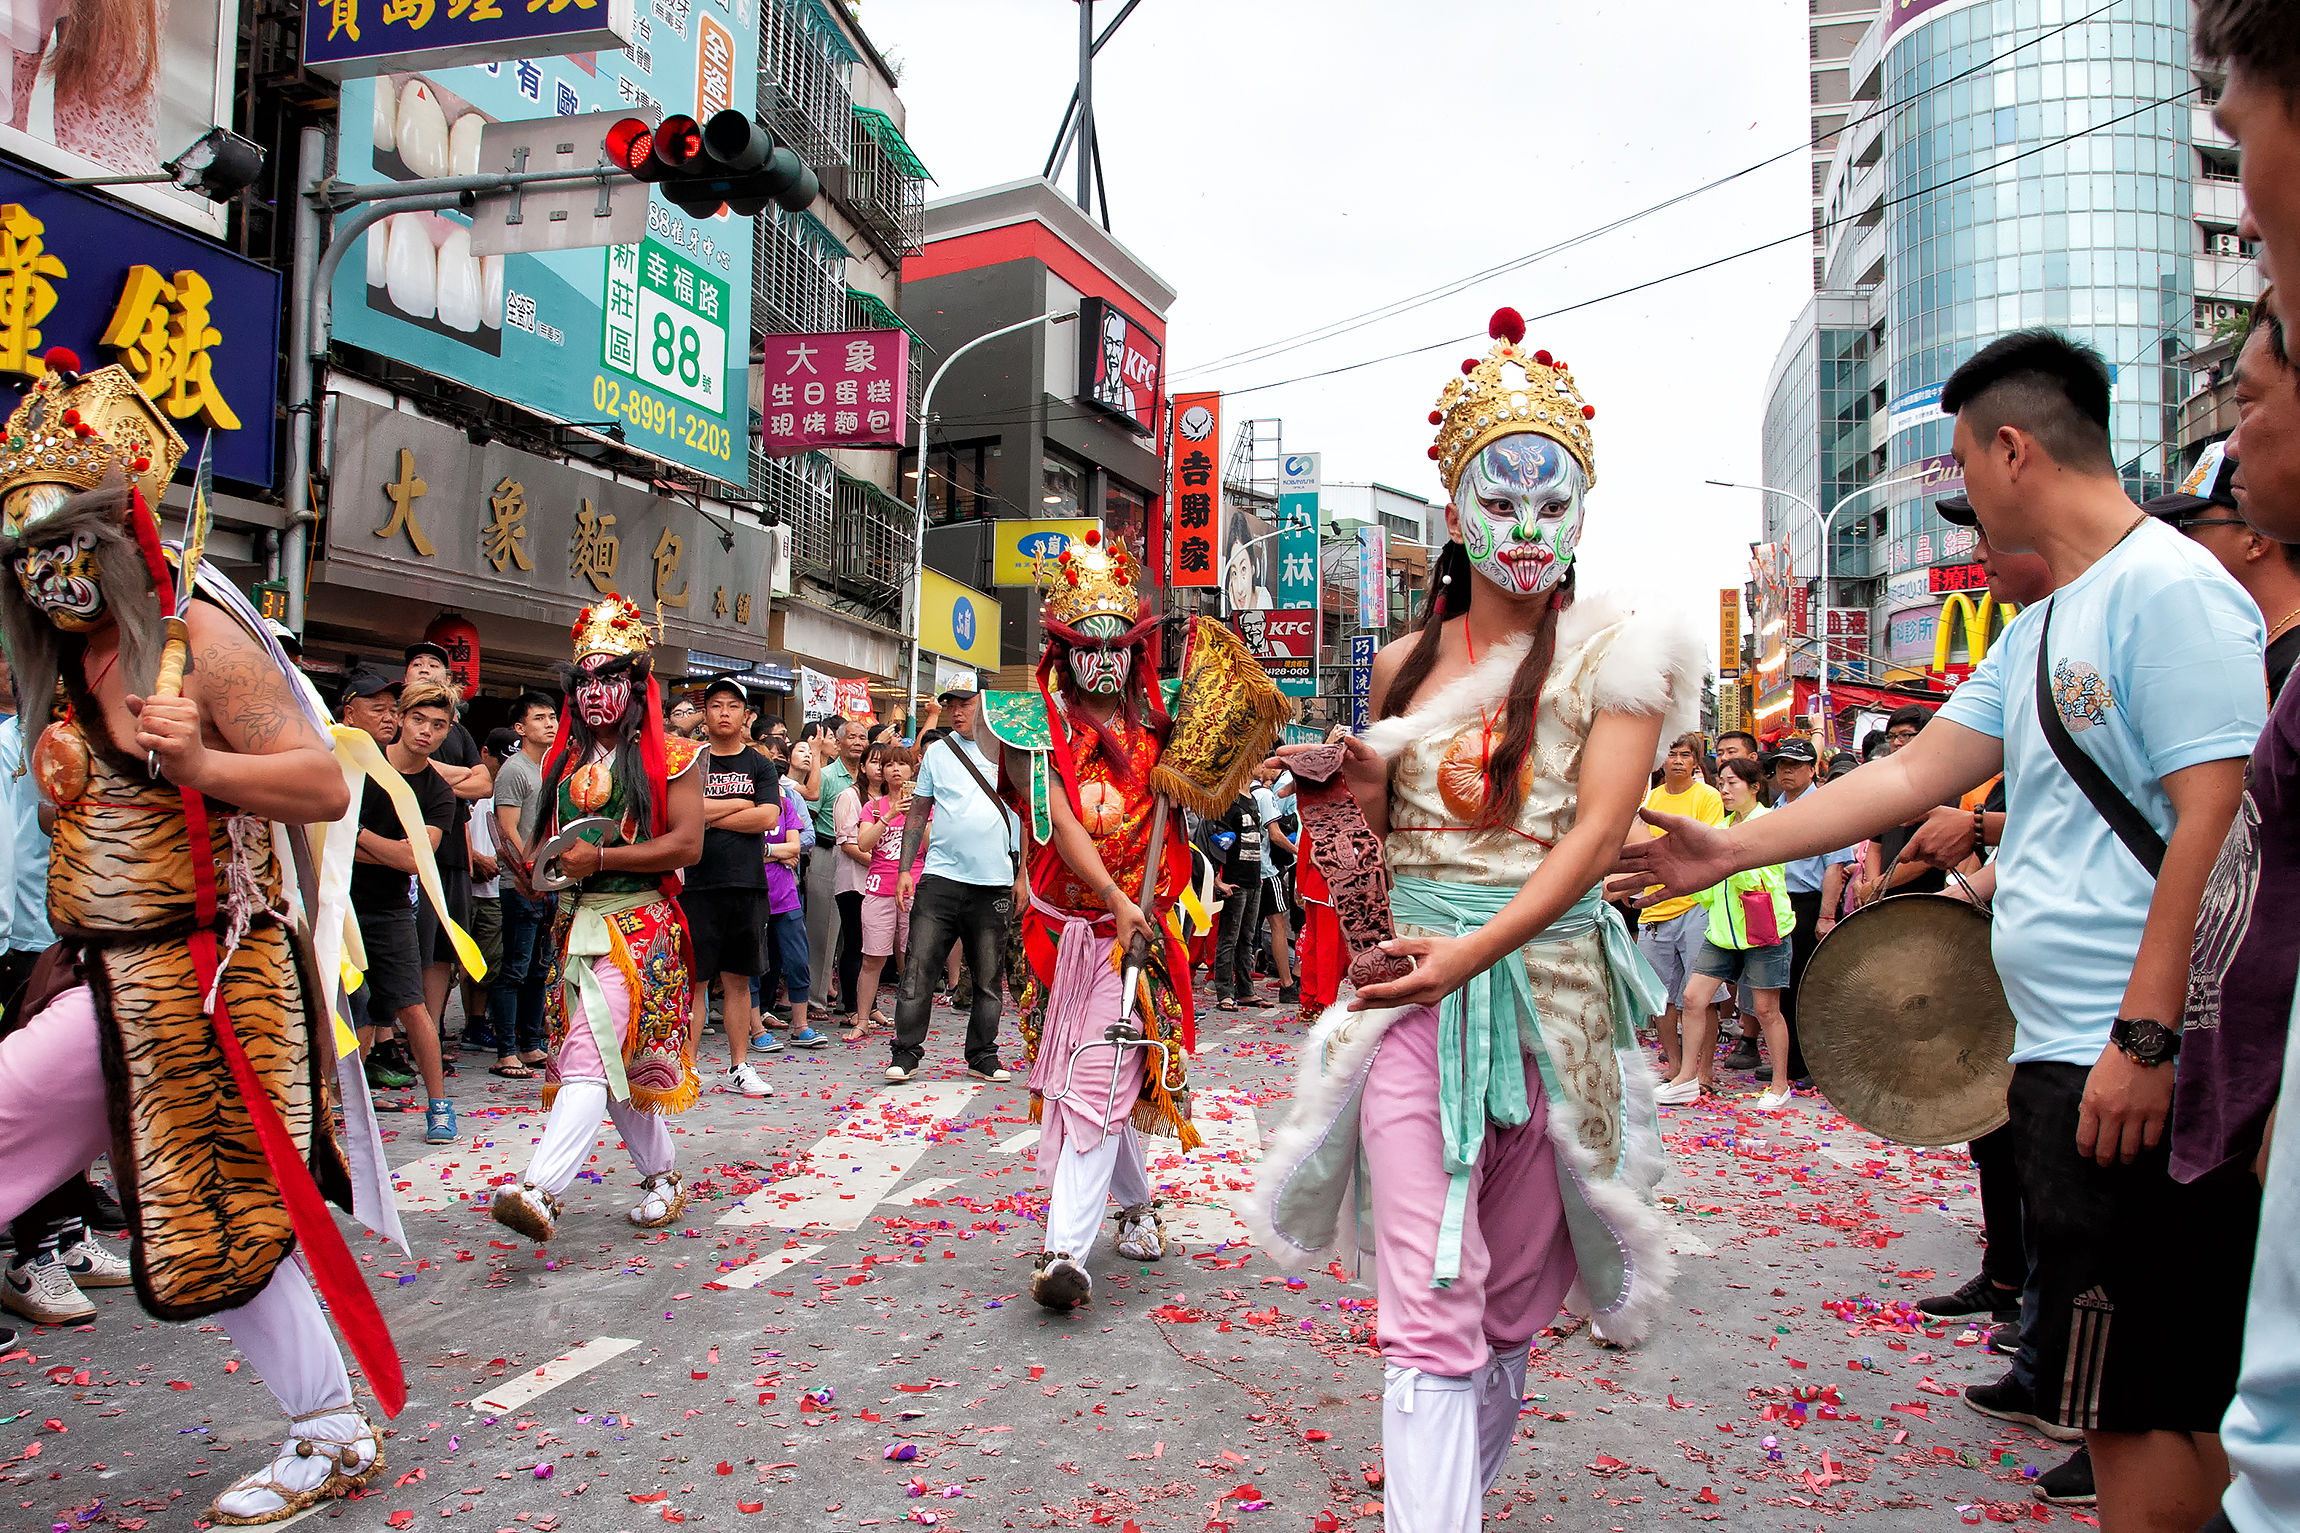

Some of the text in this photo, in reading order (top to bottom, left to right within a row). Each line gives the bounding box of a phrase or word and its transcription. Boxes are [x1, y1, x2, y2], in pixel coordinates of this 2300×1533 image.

[648, 201, 732, 271] 88植牙中心
[609, 243, 636, 366] 新莊區
[647, 251, 720, 320] 幸福路
[786, 340, 877, 375] 大象
[1123, 346, 1158, 392] KFC
[771, 379, 892, 407] 生日蛋糕
[593, 375, 731, 461] 02-8991-2203
[771, 409, 891, 437] 現烤麵包
[374, 447, 690, 608] 大象麵包
[1180, 450, 1213, 573] 吉野家
[263, 591, 285, 618] 31
[1268, 621, 1312, 636] KFC
[707, 772, 752, 786] METAL
[2073, 1298, 2114, 1311] adidas
